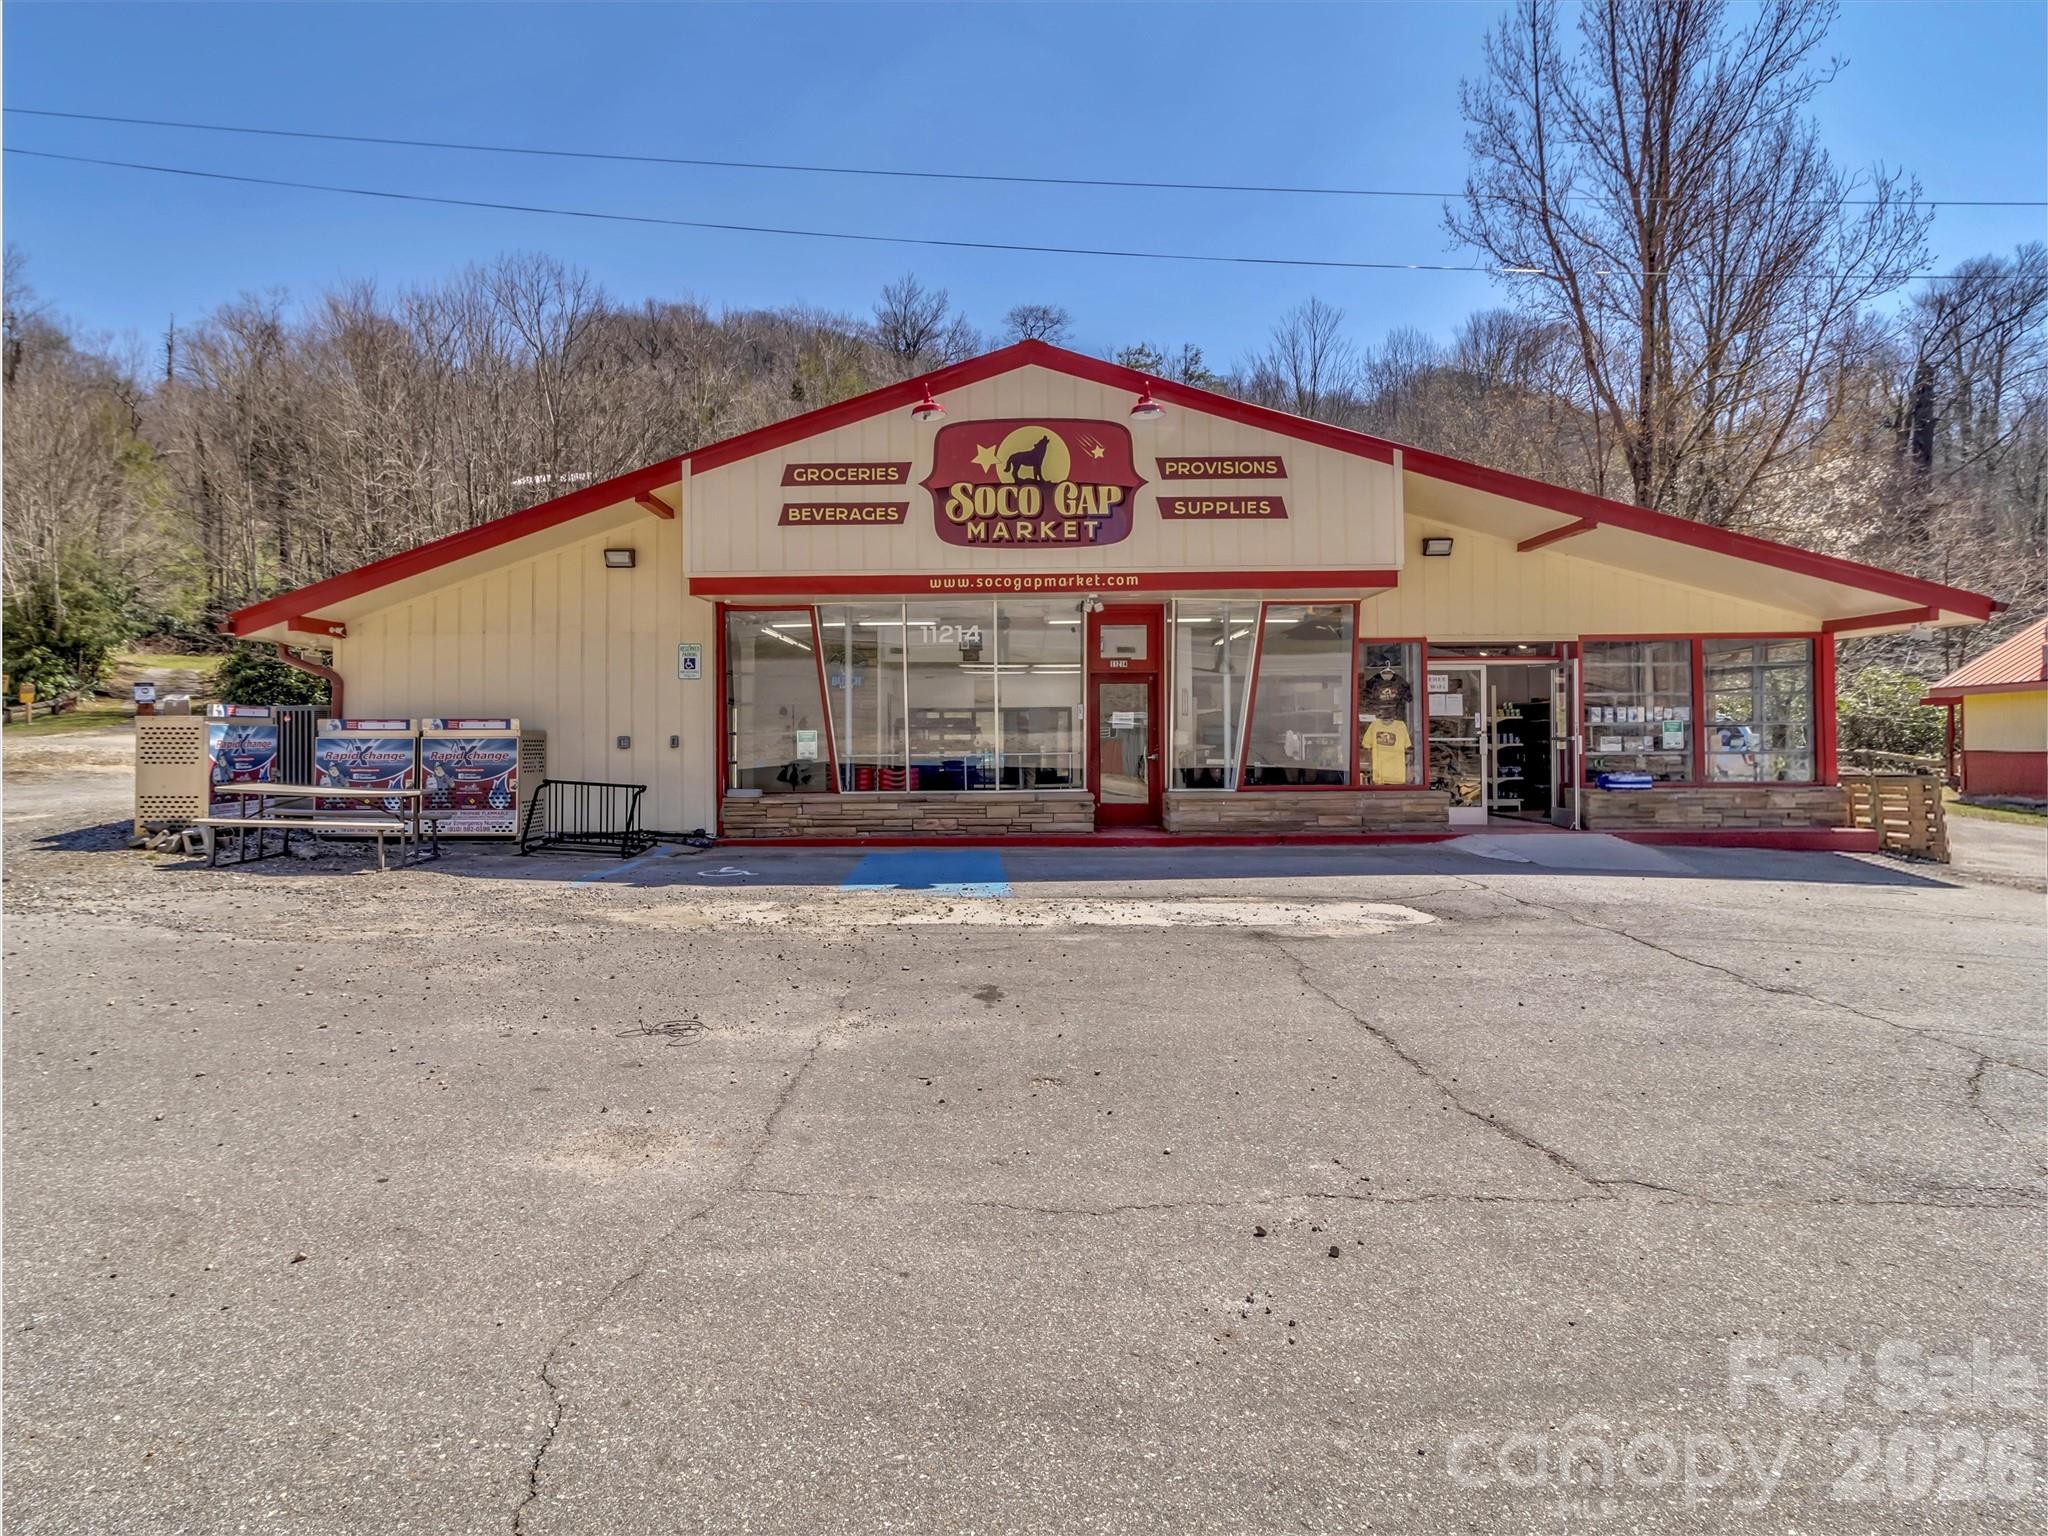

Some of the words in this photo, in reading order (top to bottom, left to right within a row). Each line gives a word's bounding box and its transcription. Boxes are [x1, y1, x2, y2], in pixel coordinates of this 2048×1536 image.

[793, 467, 899, 482] GROCERIES
[1165, 461, 1278, 475] PROVISIONS
[945, 482, 1041, 522] SOCO
[1054, 481, 1123, 516] GAP
[1174, 501, 1271, 514] SUPPLIES
[788, 507, 899, 521] BEVERAGES
[967, 520, 1099, 540] MARKET
[929, 574, 1139, 590] www.socogapmarket.com
[920, 625, 980, 643] 11214
[1110, 660, 1128, 668] 11214
